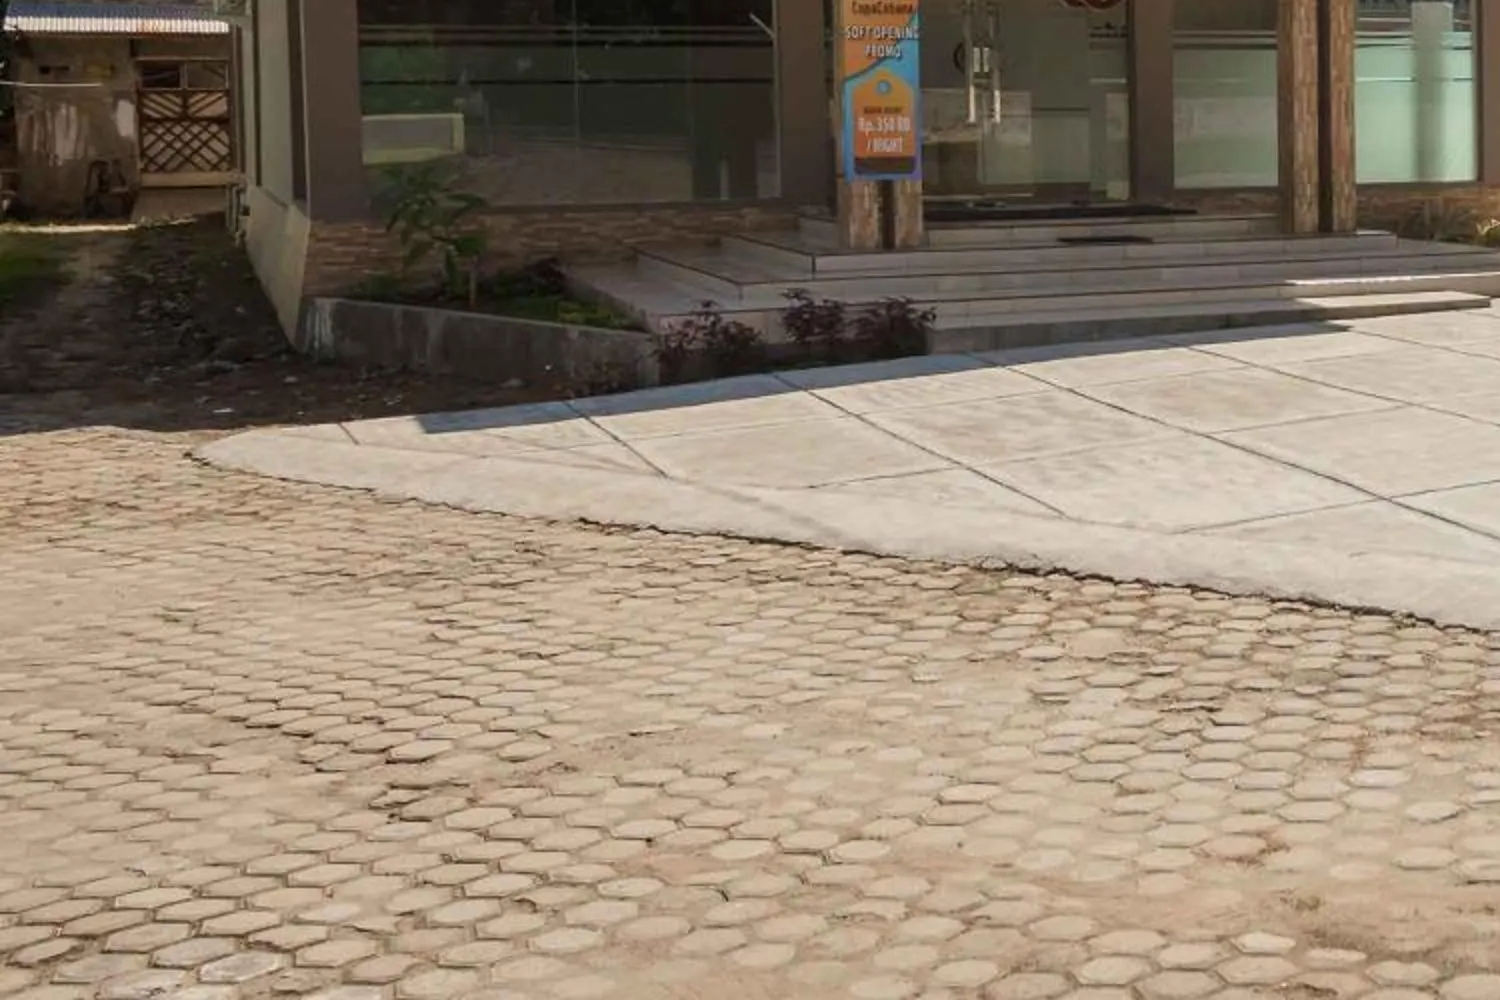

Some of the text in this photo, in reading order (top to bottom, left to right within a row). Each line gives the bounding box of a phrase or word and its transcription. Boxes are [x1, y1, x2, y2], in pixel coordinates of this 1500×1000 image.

[847, 25, 920, 39] SOFT OPENING
[864, 44, 902, 58] PROMO
